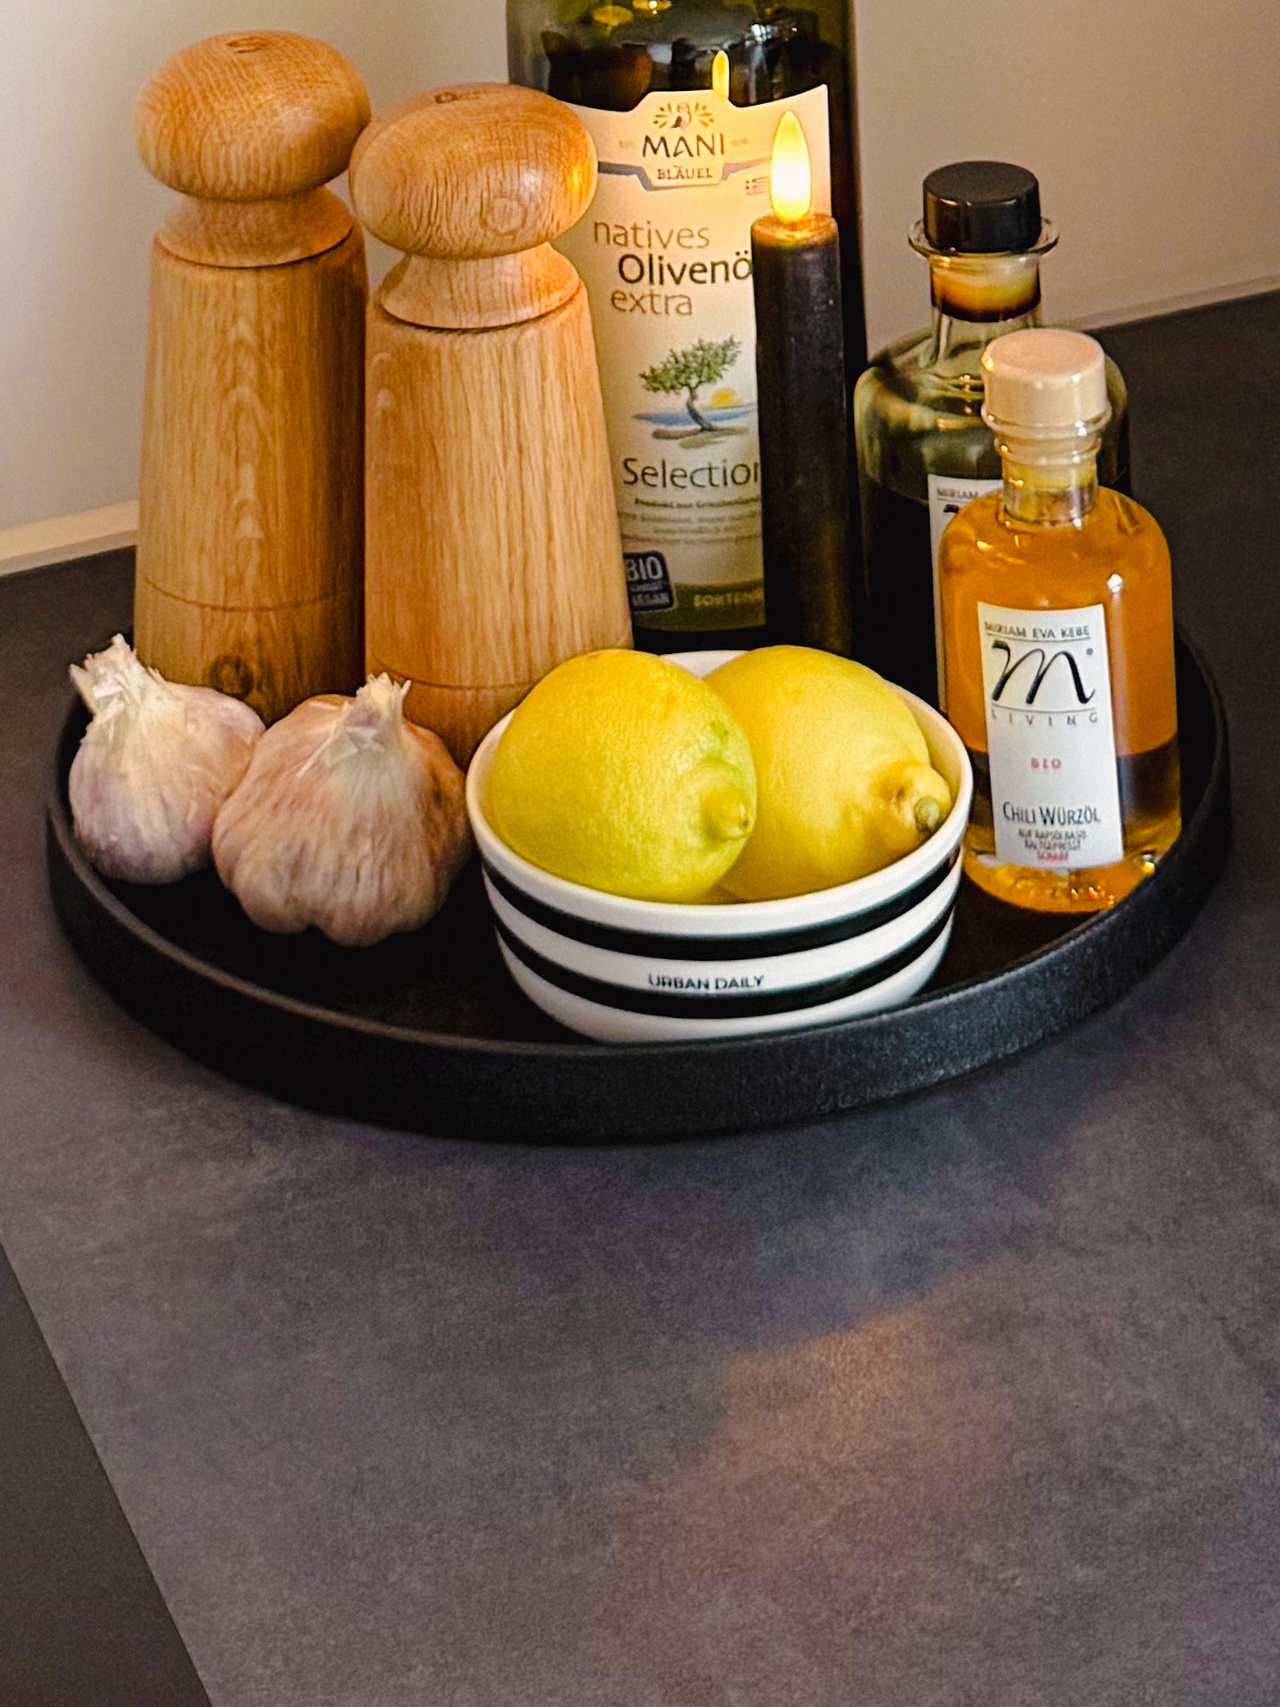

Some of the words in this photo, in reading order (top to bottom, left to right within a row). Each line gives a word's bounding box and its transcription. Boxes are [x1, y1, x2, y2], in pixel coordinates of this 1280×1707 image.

[642, 133, 725, 158] MANI
[594, 220, 710, 249] natives
[611, 289, 692, 315] extra
[984, 621, 1027, 637] MIRIAM
[1032, 627, 1056, 638] EVA
[1061, 625, 1090, 637] KEBE
[991, 708, 1098, 727] LIVING
[1030, 757, 1062, 770] BIO
[648, 972, 710, 990] URBAN
[714, 974, 765, 990] DAILY
